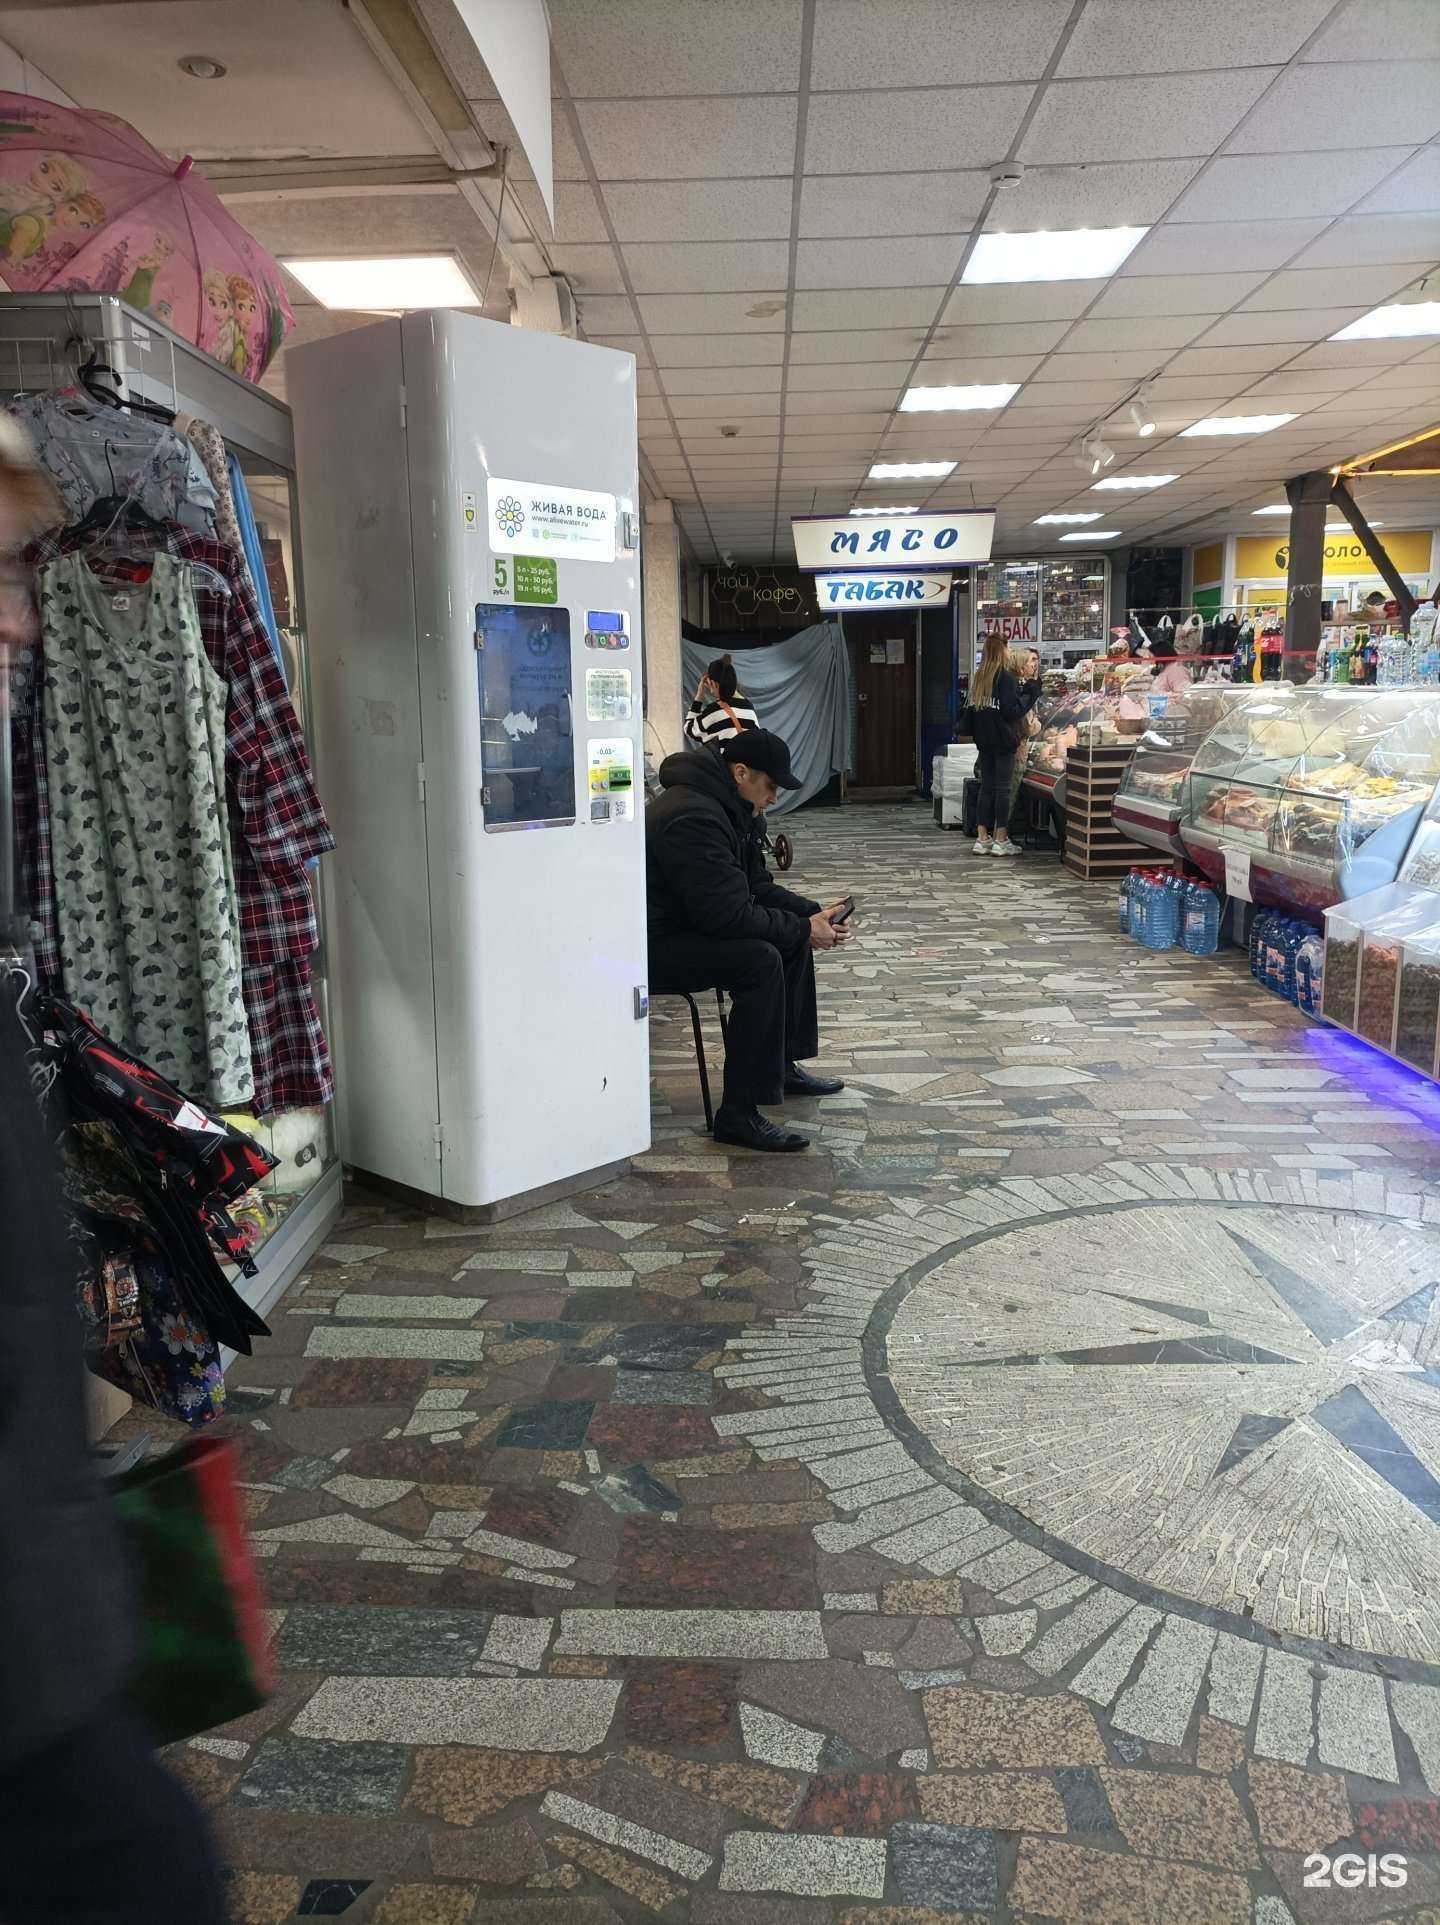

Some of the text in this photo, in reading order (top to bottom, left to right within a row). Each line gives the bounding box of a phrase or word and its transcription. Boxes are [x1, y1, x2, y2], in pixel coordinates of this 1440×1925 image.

[531, 500, 607, 521] ЖИВАЯ ВОДА
[830, 527, 959, 555] МЯСО
[494, 559, 508, 588] 5
[753, 587, 795, 603] кофе
[827, 579, 926, 603] ТАБАК
